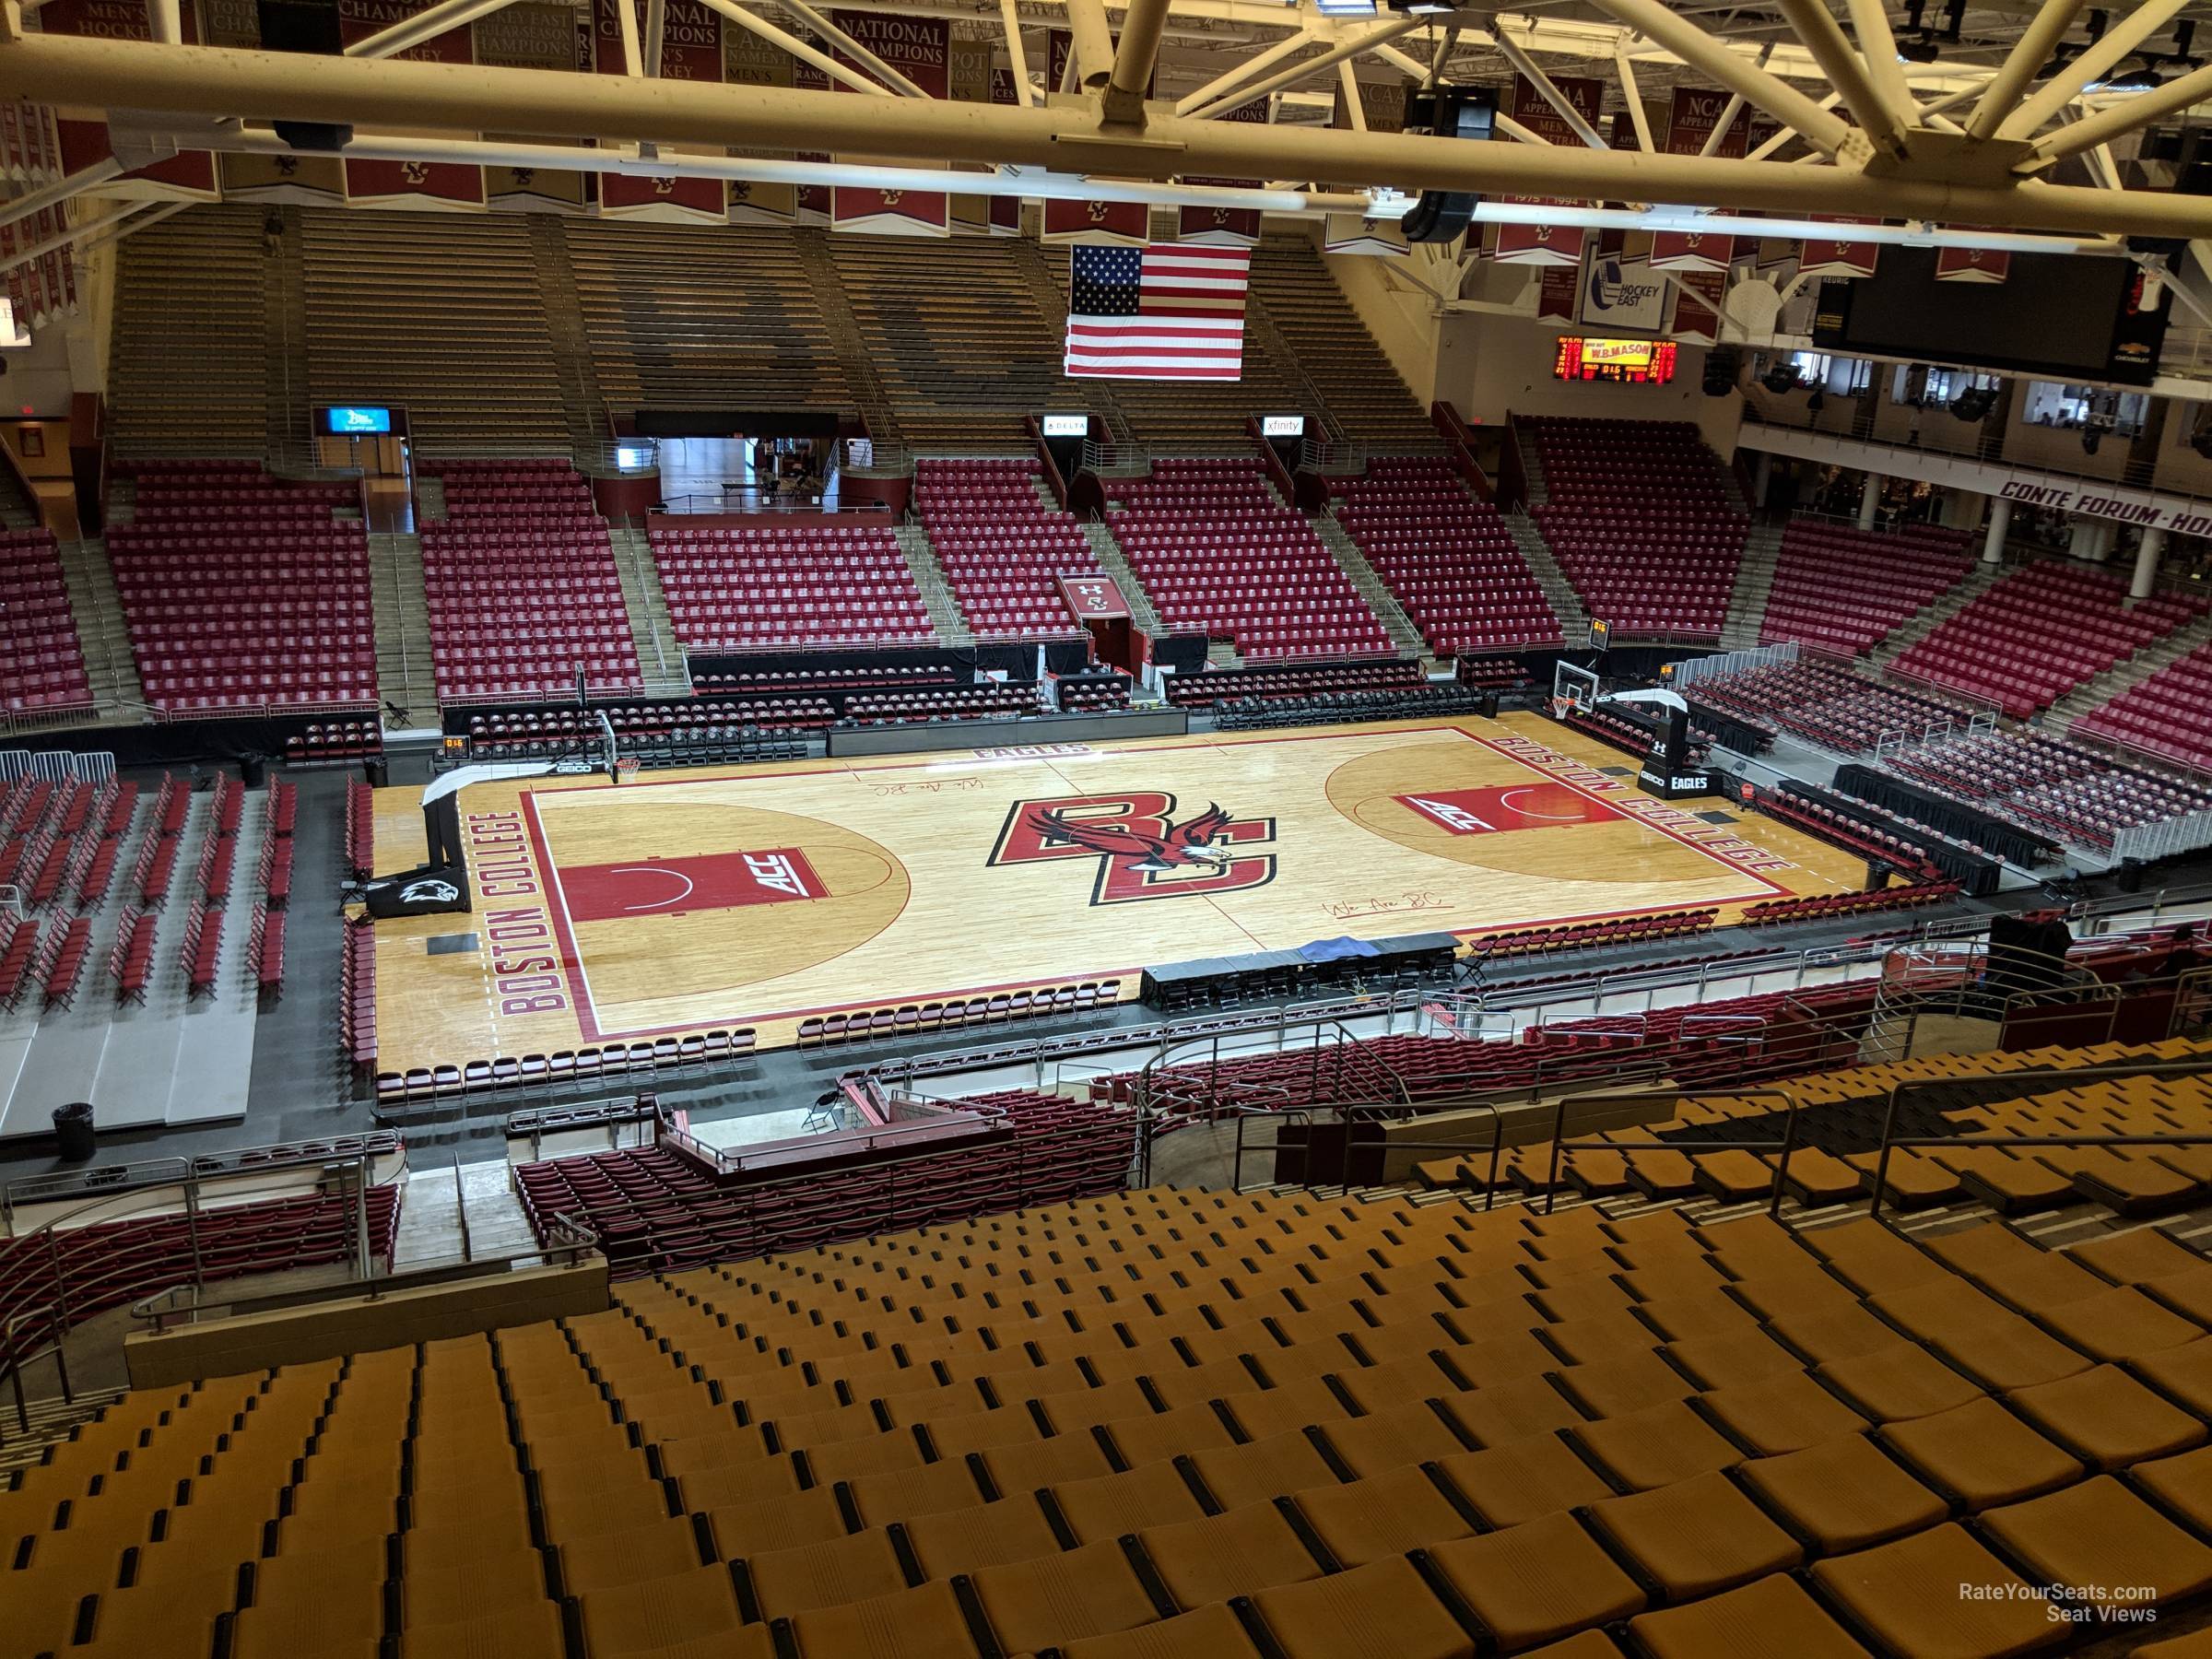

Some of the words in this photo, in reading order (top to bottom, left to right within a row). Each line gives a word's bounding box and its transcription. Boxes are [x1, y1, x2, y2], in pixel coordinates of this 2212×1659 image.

[839, 18, 944, 47] NATIONAL
[1620, 284, 1660, 298] HOCKEY
[1618, 295, 1642, 306] EAST
[1267, 420, 1300, 432] xfinity
[1999, 481, 2073, 508] CONTE
[2074, 494, 2162, 525] FORUM
[973, 742, 1092, 759] EAGLES
[557, 765, 592, 773] GEICO
[1640, 771, 1665, 787] GEICO
[1671, 776, 1708, 790] EAGLES
[1488, 736, 1630, 794] BOSTON
[1615, 797, 1800, 873] COLLEGE
[1416, 797, 1498, 830] ACC
[466, 811, 539, 898] COLLEGE
[742, 853, 799, 895] ACC
[1402, 891, 1442, 908] BC
[484, 906, 569, 1017] BOSTON
